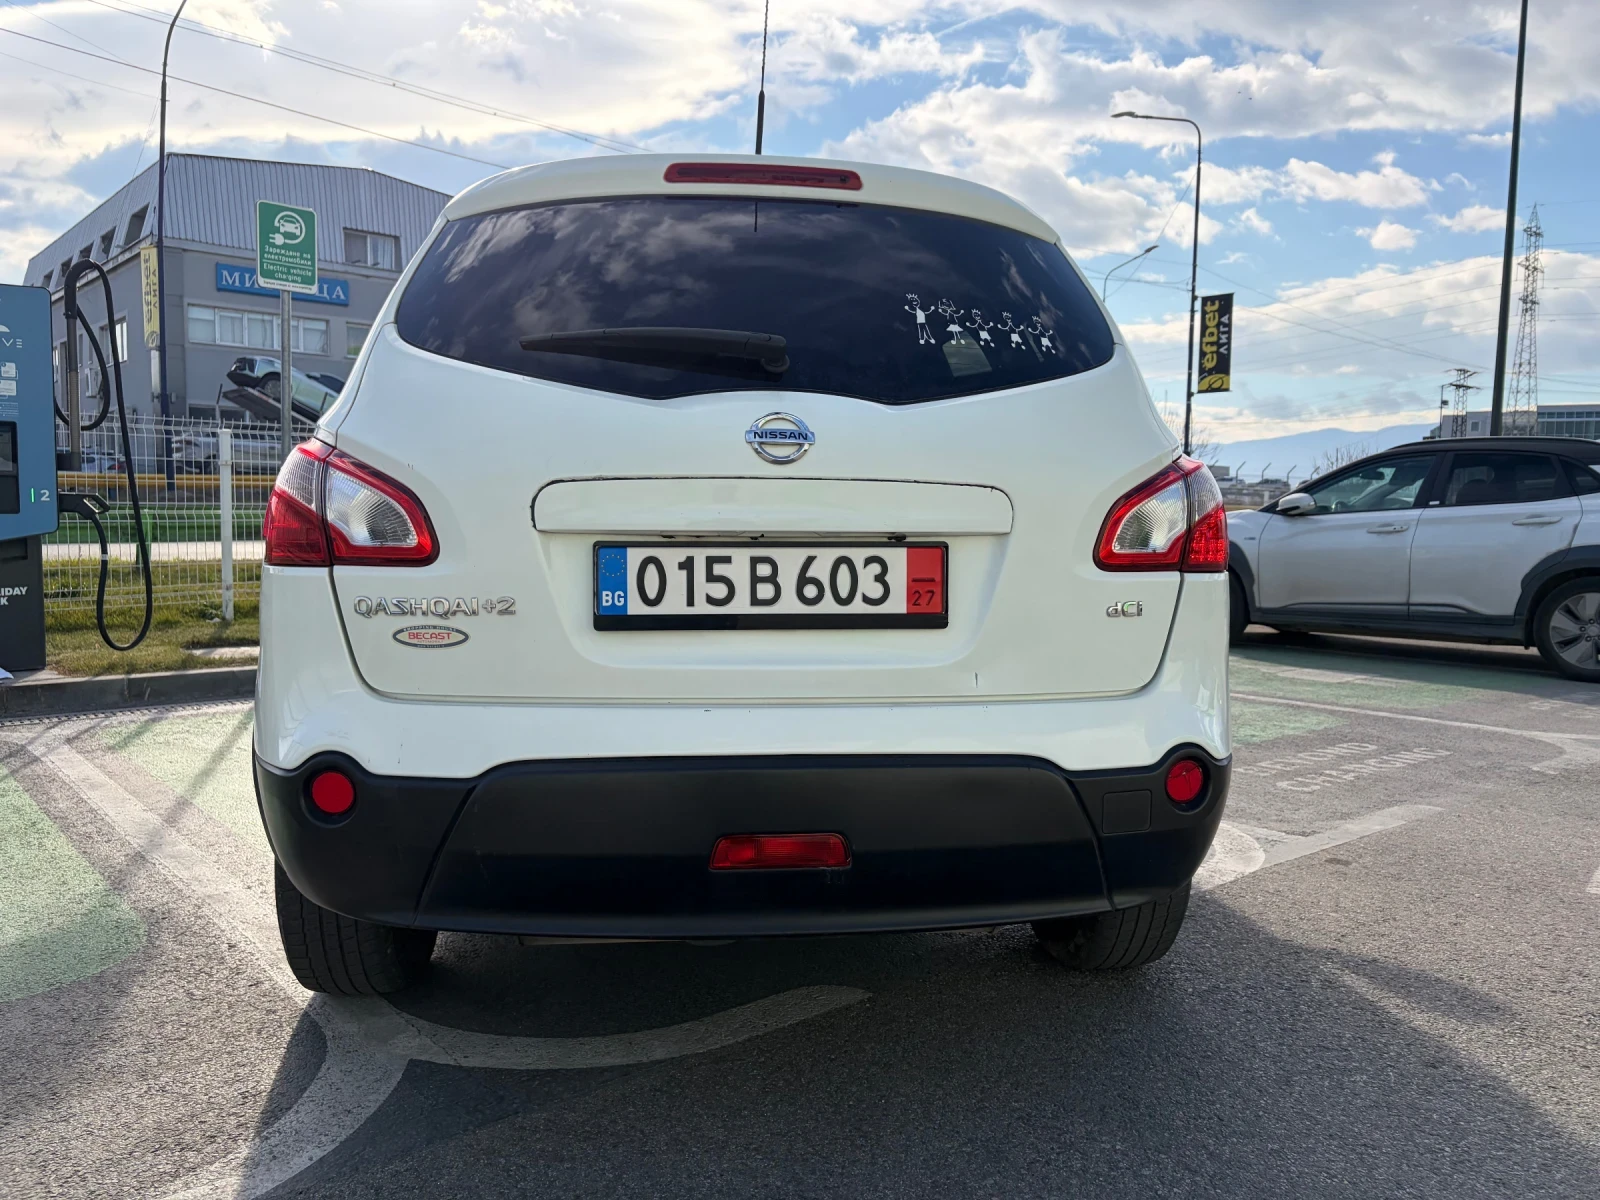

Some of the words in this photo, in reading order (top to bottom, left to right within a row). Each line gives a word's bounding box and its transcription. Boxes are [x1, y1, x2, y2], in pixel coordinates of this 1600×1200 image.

[264, 245, 300, 257] Зареждане
[263, 262, 288, 272] Electric
[290, 269, 312, 277] vehicle
[274, 272, 302, 282] charging
[1219, 314, 1229, 354] ЛИГА
[753, 431, 808, 441] NISSAN
[40, 489, 50, 501] 2
[0, 586, 28, 596] IDAY
[602, 590, 625, 606] BG
[911, 589, 936, 607] 27
[1106, 601, 1142, 618] dCi
[408, 631, 452, 640] BECAST
